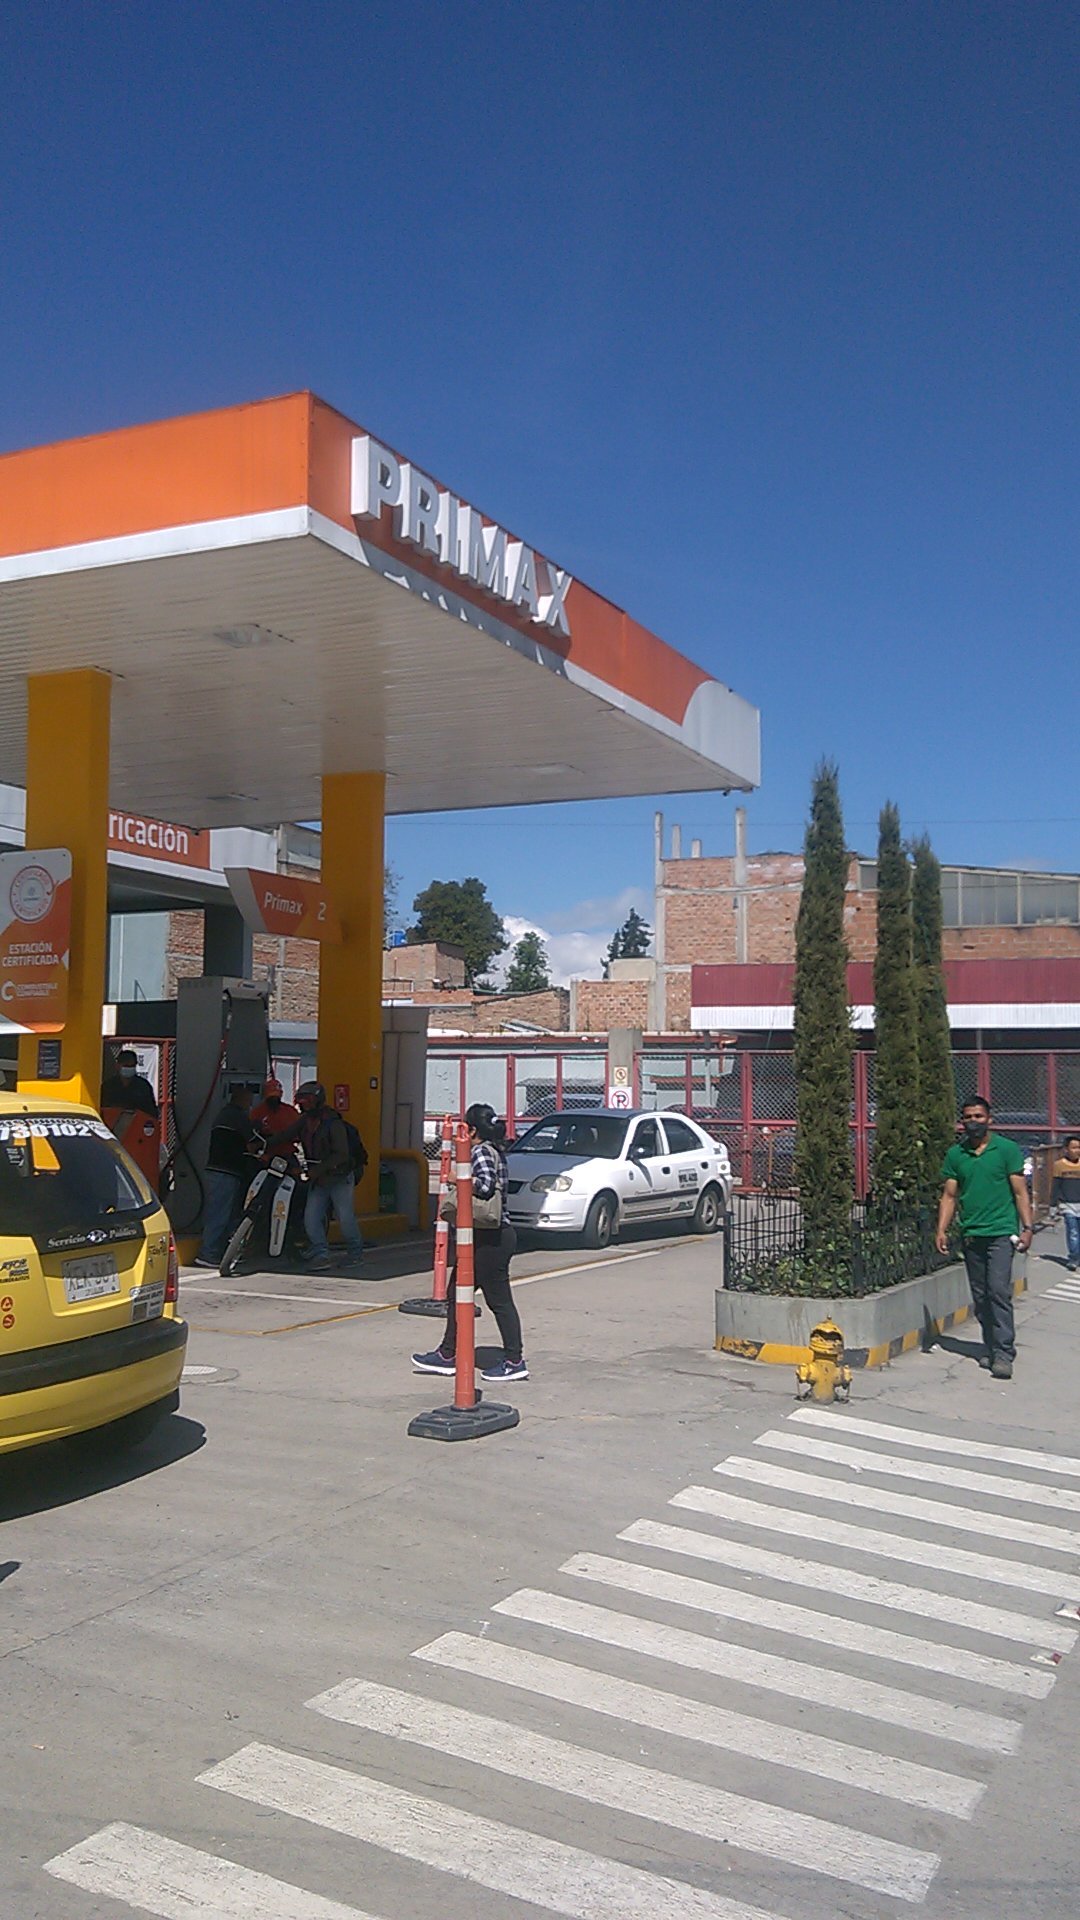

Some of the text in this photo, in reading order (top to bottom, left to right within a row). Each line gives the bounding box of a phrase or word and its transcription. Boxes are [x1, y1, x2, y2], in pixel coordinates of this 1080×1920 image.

[351, 434, 572, 637] PRIMAX
[108, 811, 188, 855] ricación
[264, 891, 327, 921] Primax 2
[9, 941, 52, 954] ESTACIÓN
[2, 954, 60, 967] CERTIFICADA
[48, 1233, 86, 1248] Servicio
